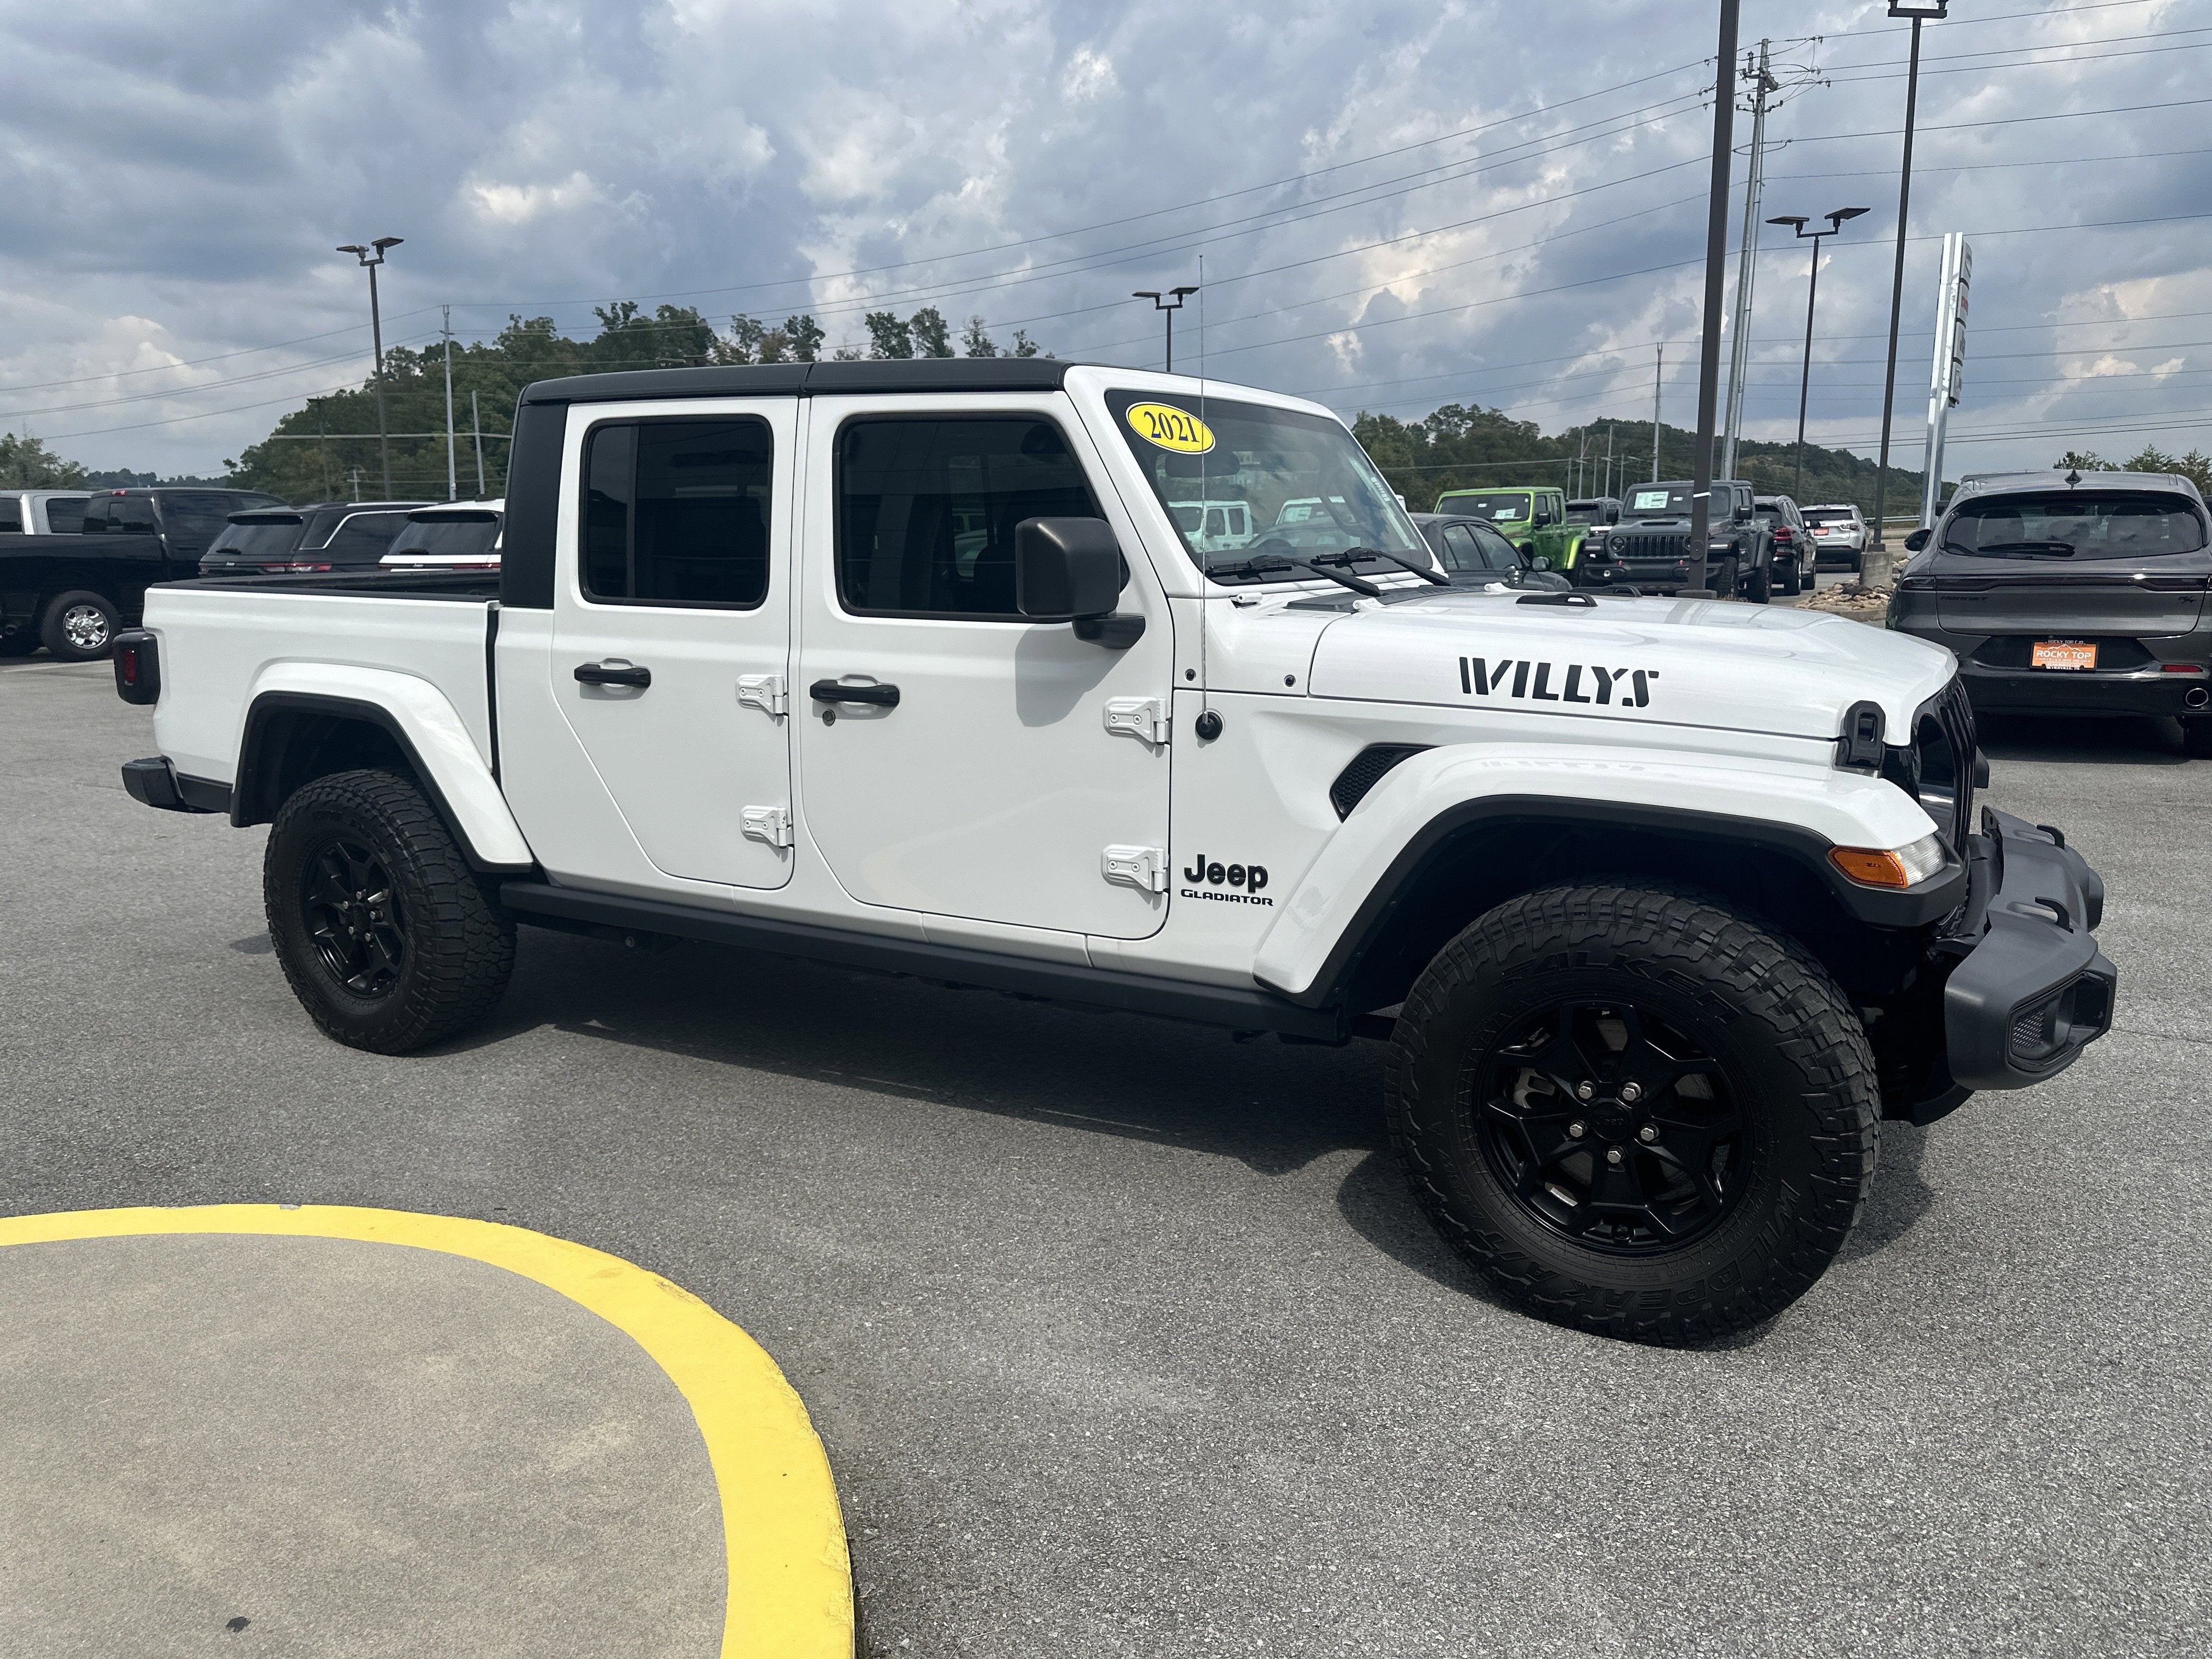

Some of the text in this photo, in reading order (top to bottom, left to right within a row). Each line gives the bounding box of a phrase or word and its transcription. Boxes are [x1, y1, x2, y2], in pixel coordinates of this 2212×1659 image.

[1144, 411, 1200, 442] 2021
[2036, 650, 2092, 659] ROCKY TOP
[1459, 656, 1660, 708] WILLYS
[1184, 854, 1268, 894] Jeep
[1181, 889, 1274, 906] GLADIATOR
[1562, 1179, 1801, 1311] WILDPEAK
